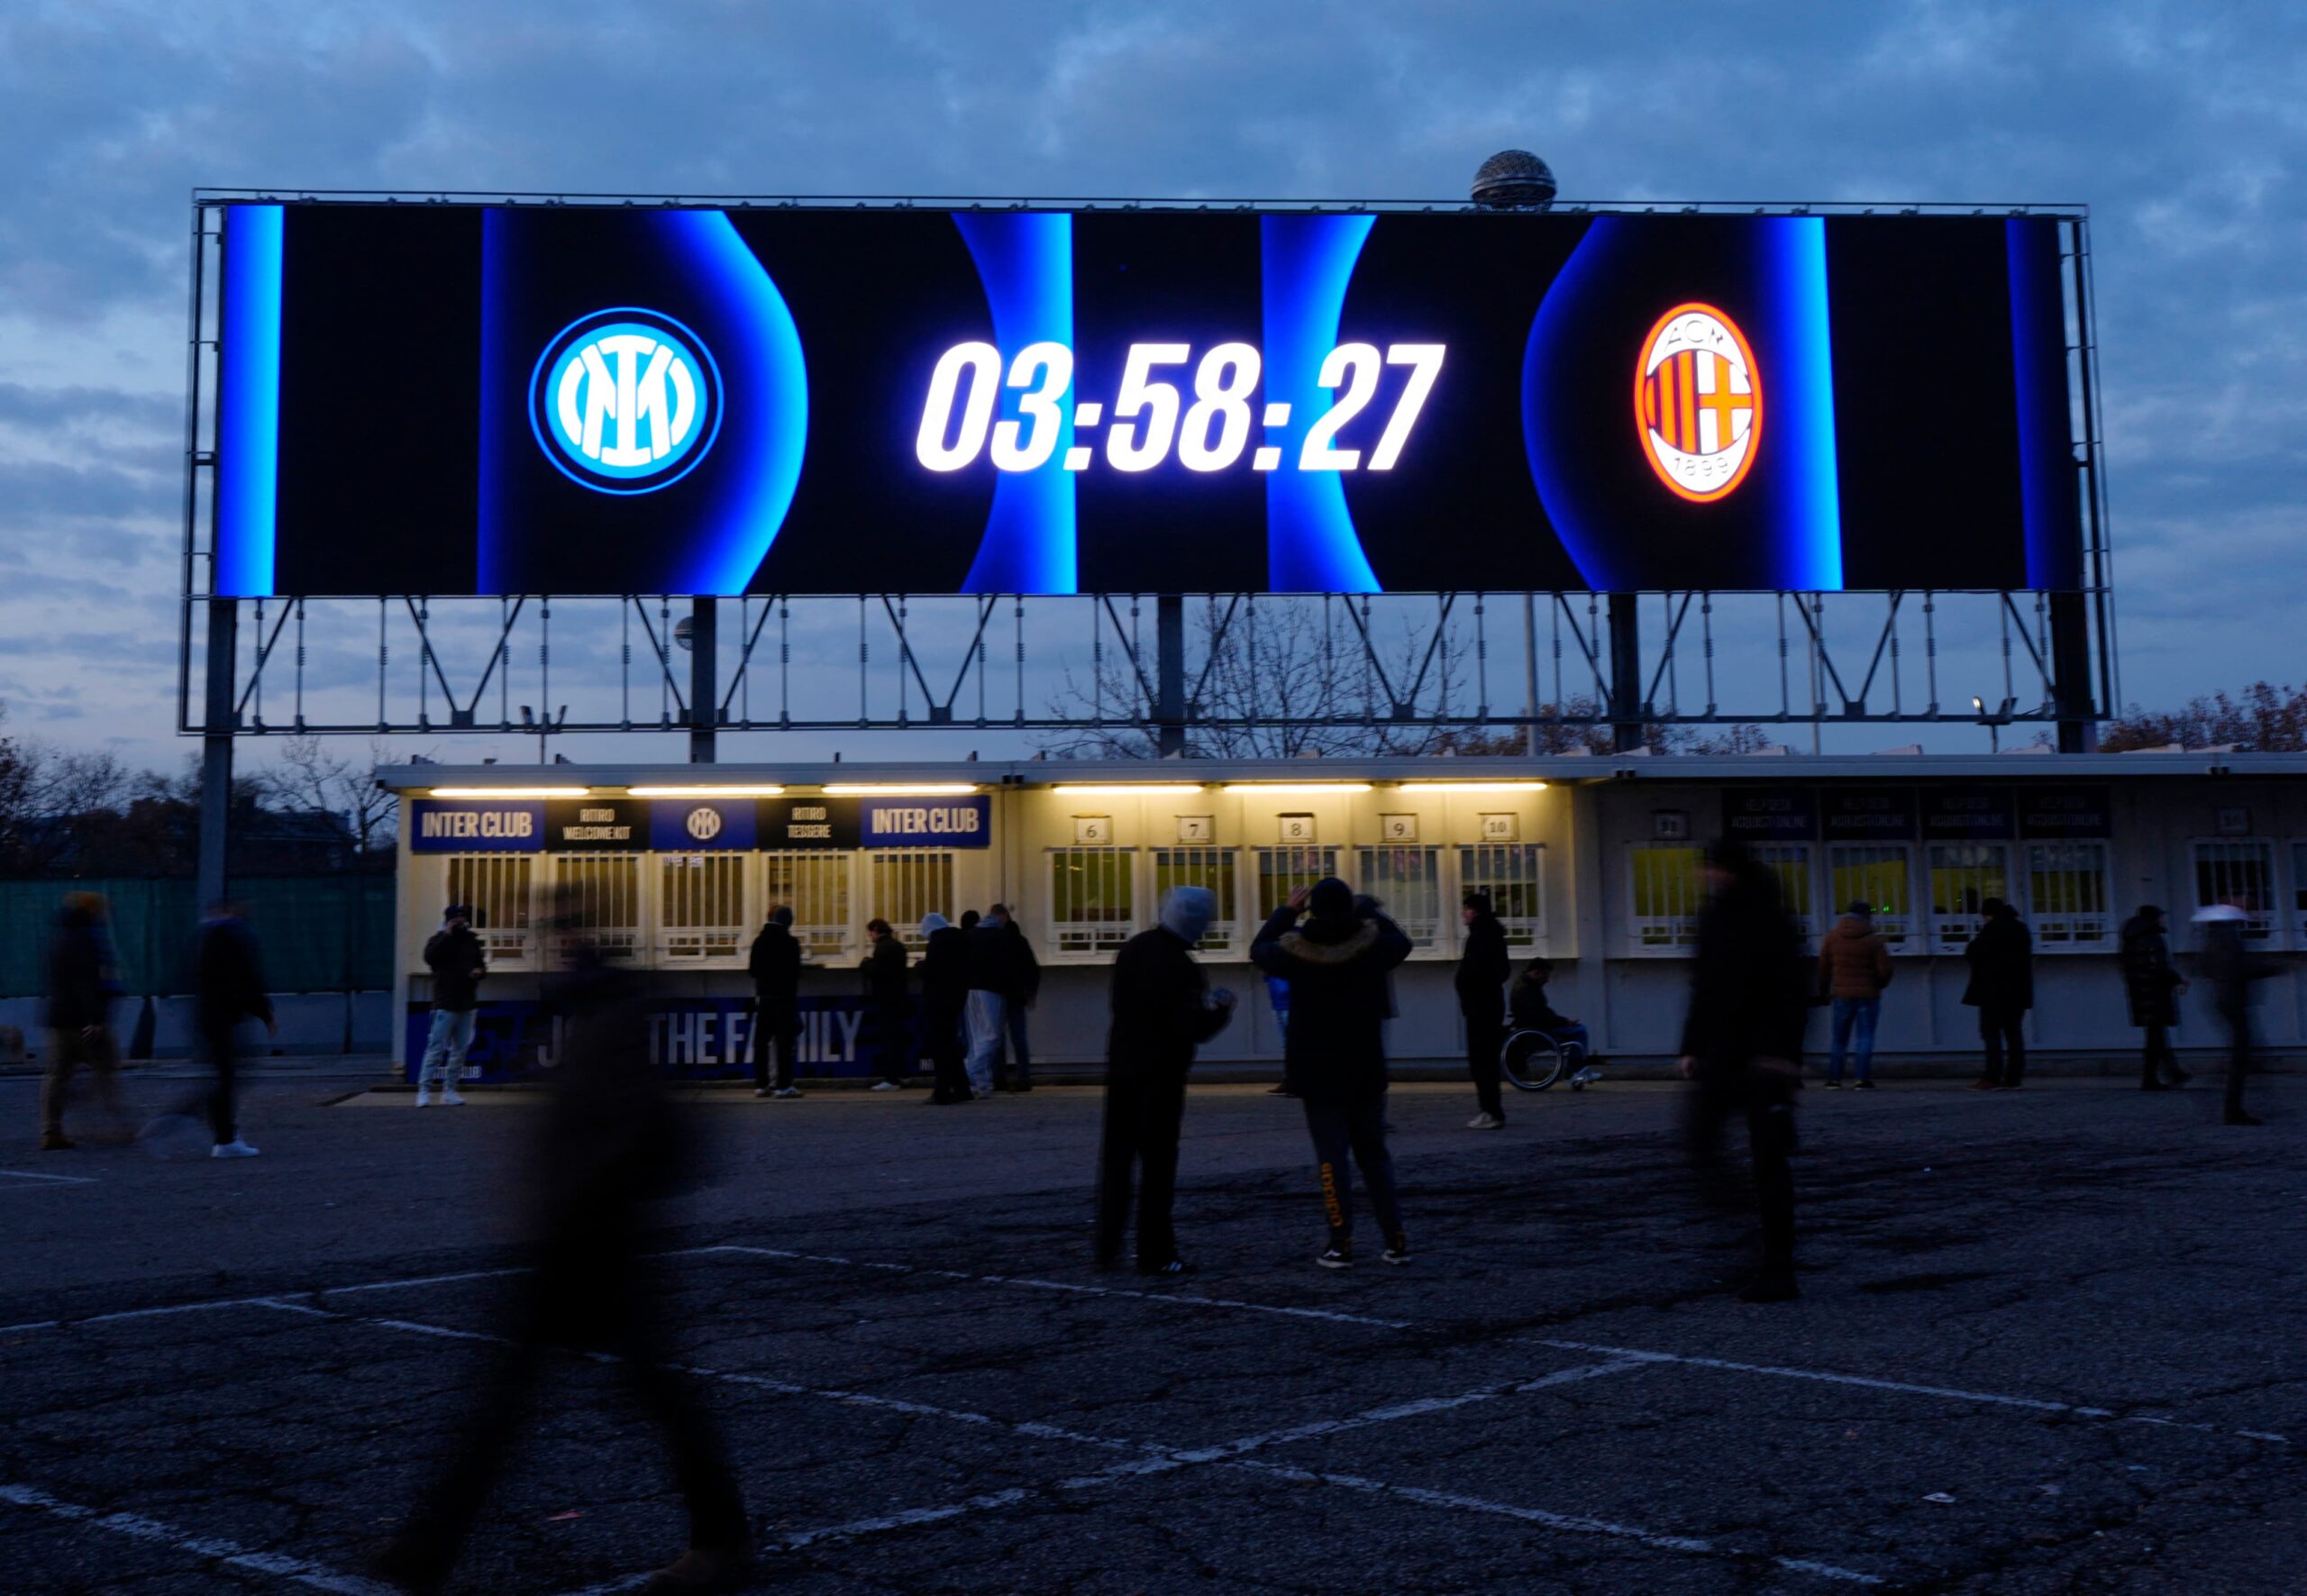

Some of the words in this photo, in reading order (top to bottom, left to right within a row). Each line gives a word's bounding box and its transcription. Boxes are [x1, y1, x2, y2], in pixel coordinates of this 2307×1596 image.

[916, 341, 1446, 472] 03:58:27
[422, 812, 479, 837] INTER
[480, 812, 532, 837] CLUB
[871, 808, 927, 834] INTER
[928, 807, 979, 833] CLUB
[563, 826, 614, 840] WELCOME
[1086, 825, 1098, 838] 6
[1189, 824, 1199, 837] 7
[1290, 823, 1302, 836] 8
[1394, 823, 1405, 836] 9
[1490, 822, 1507, 833] 10
[645, 1012, 718, 1065] THE
